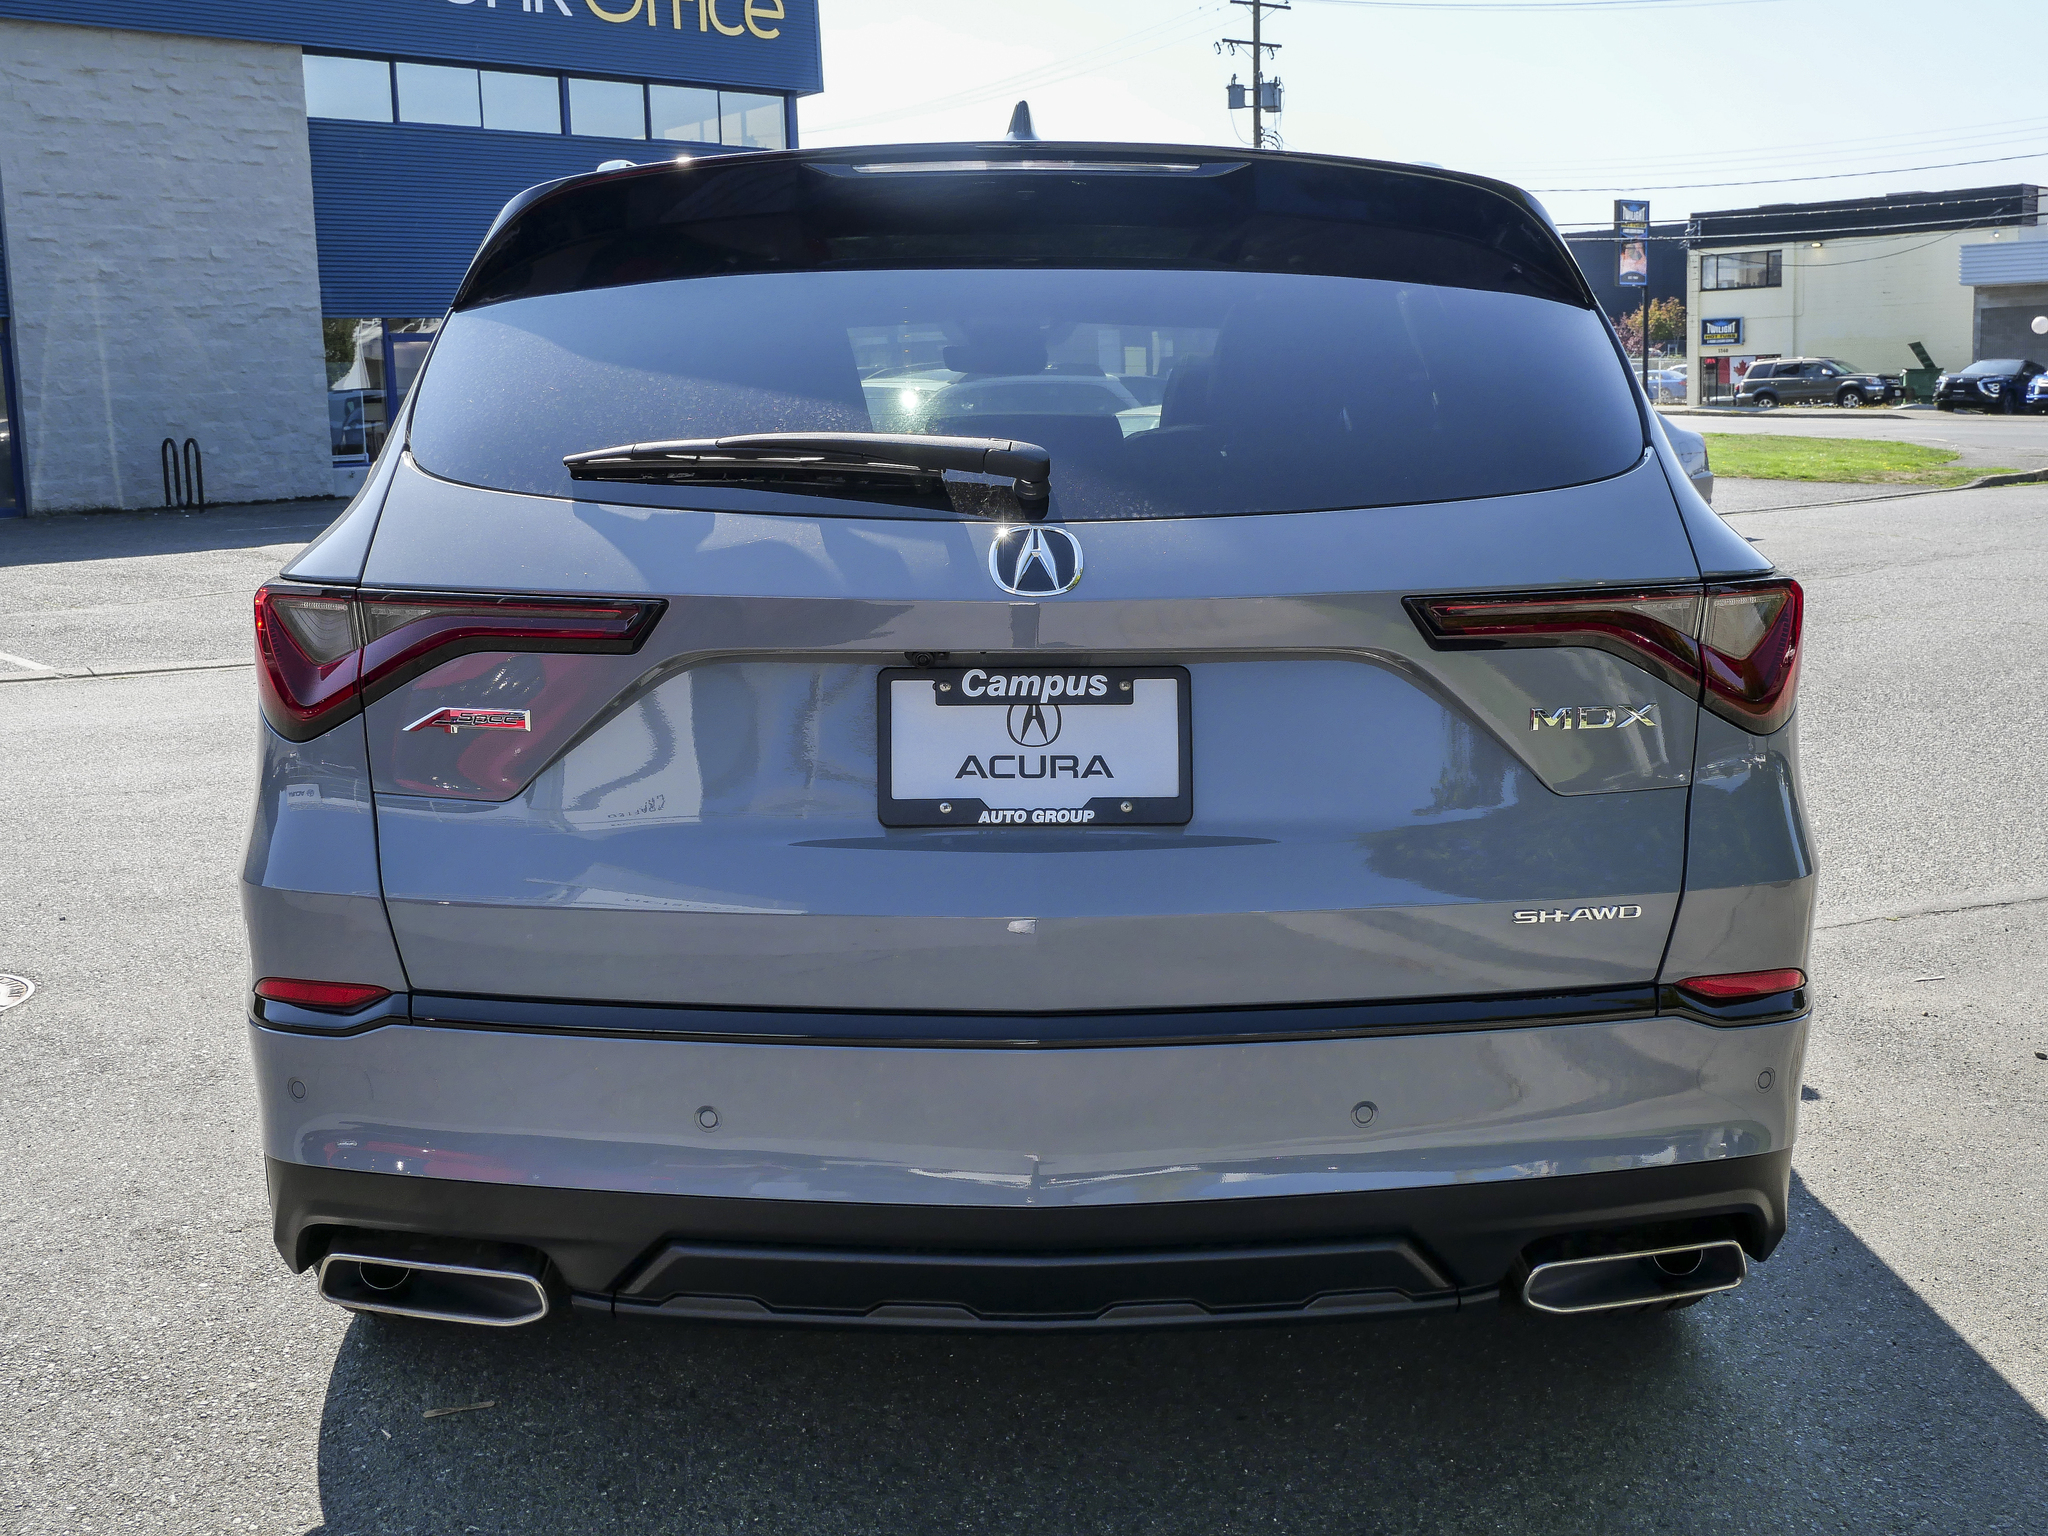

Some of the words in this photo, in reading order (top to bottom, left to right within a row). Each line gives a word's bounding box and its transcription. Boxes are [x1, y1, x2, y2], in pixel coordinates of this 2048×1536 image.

[1706, 321, 1736, 333] TWILIGHT
[961, 668, 1108, 703] Campus
[1530, 703, 1658, 731] MDX
[955, 754, 1115, 779] ACURA
[978, 809, 1027, 824] AUTO
[1031, 809, 1095, 823] GROUP
[1513, 905, 1642, 924] SH-AWD
